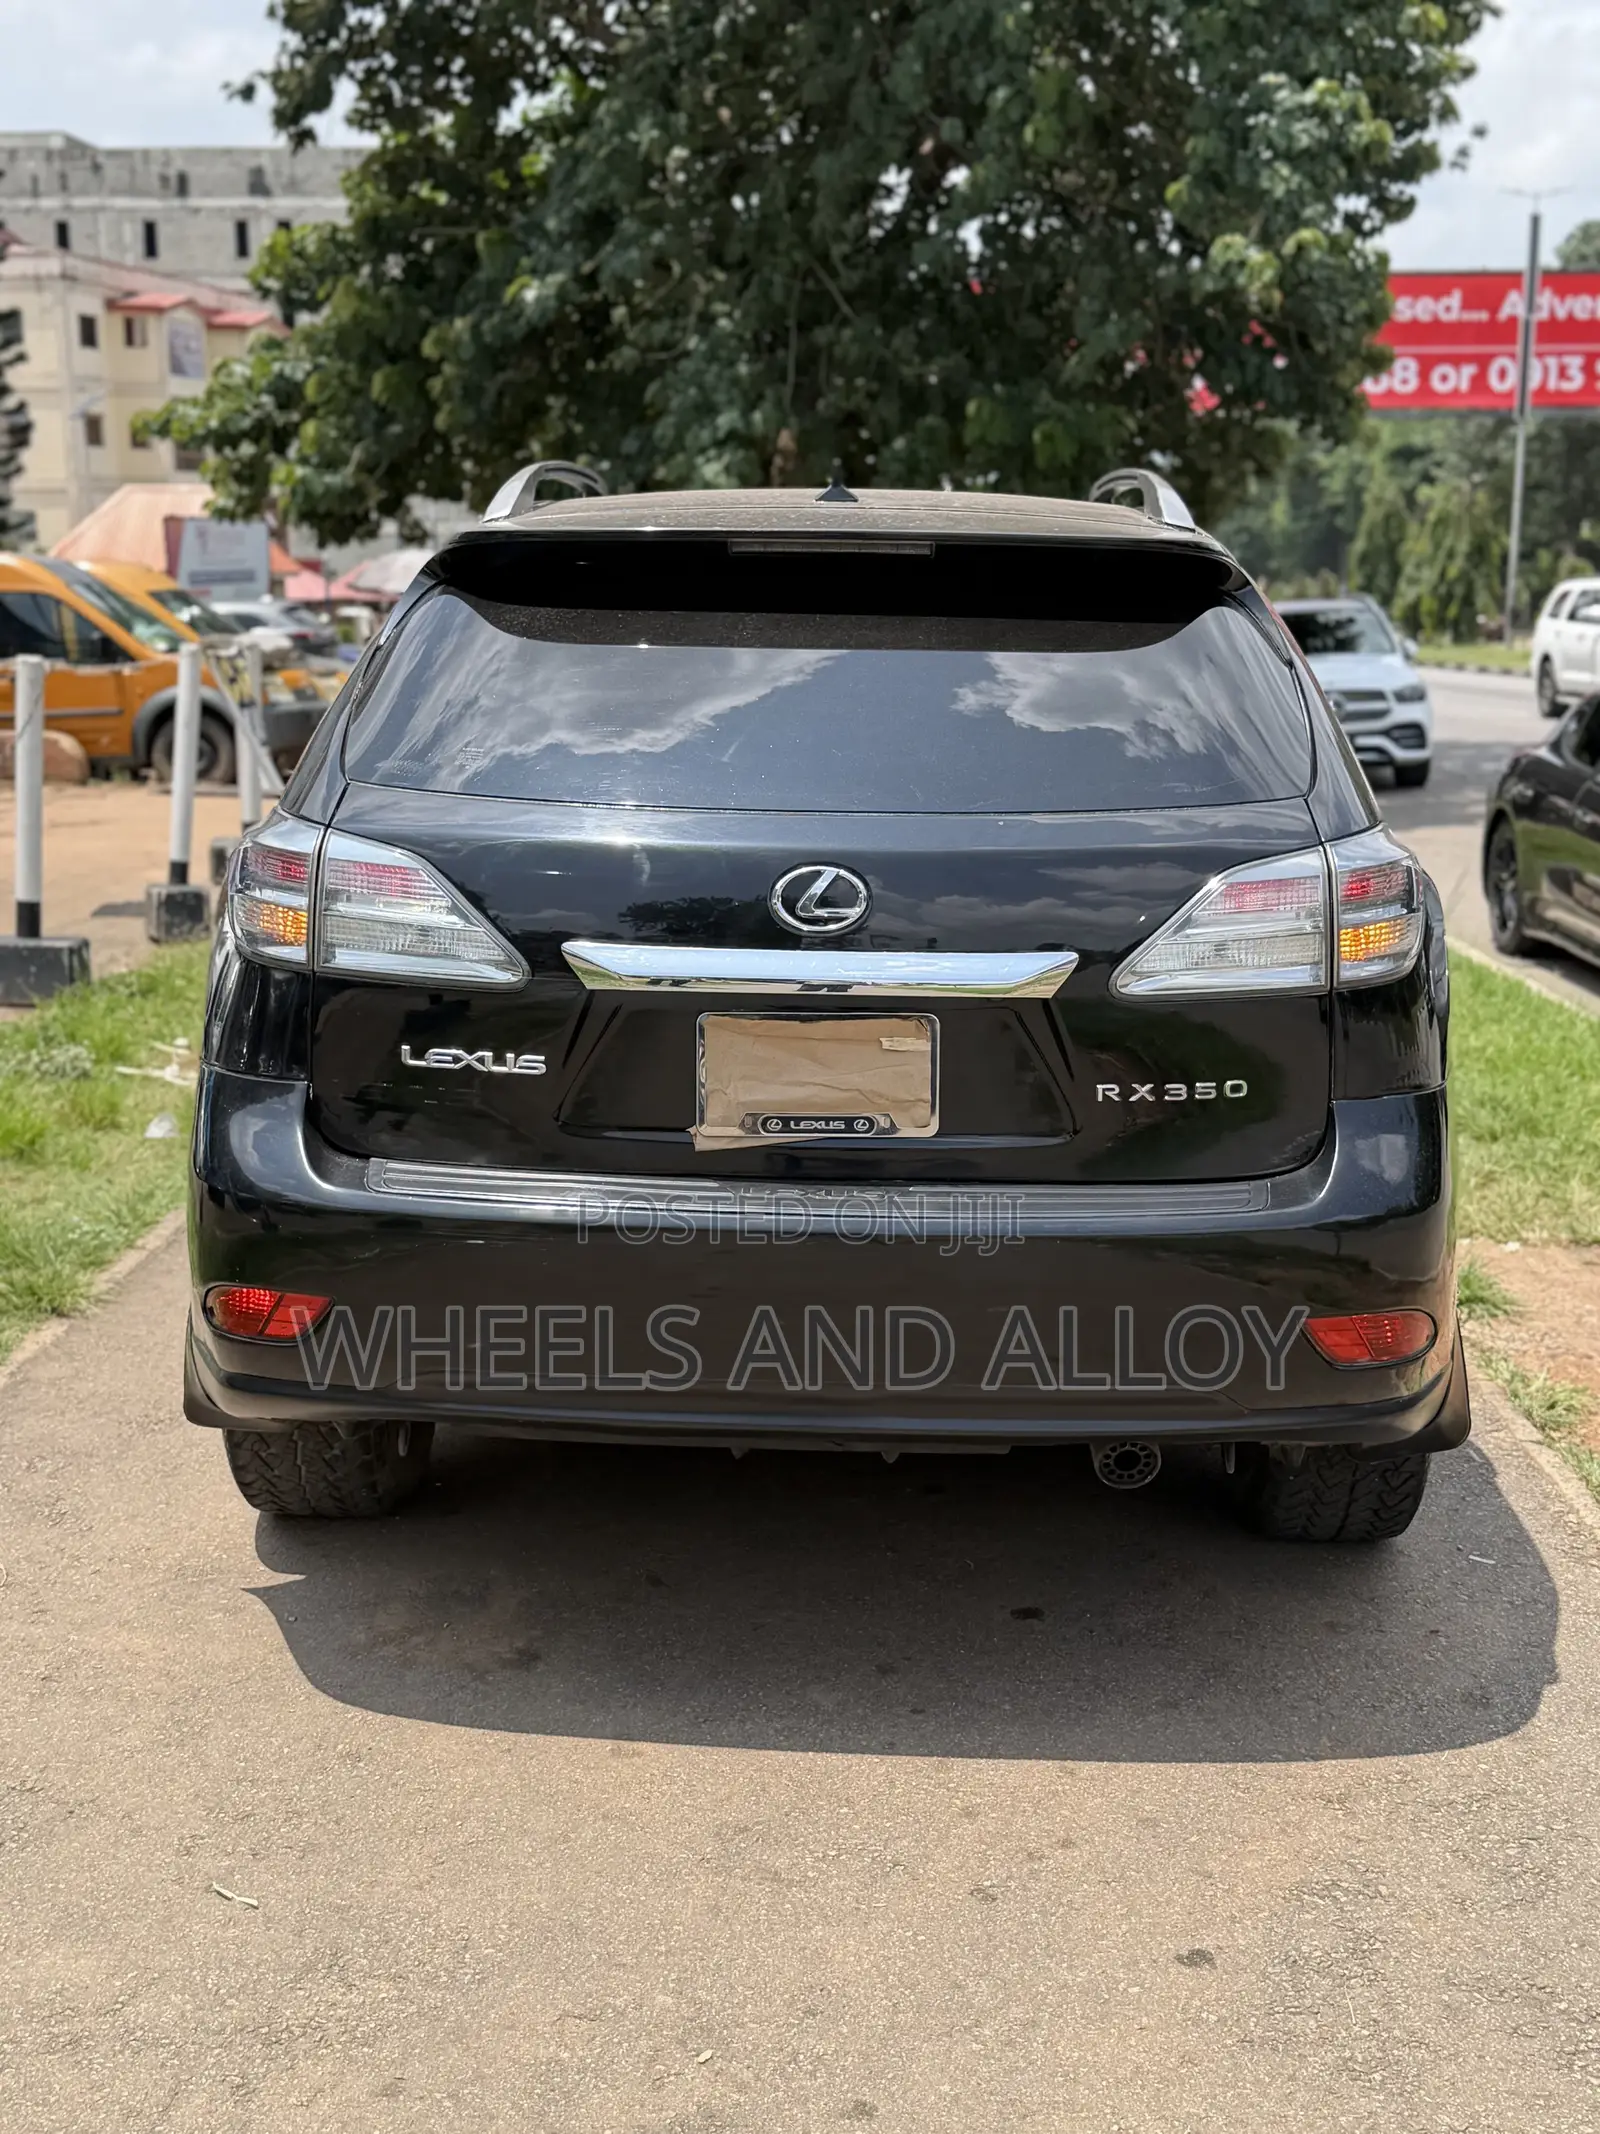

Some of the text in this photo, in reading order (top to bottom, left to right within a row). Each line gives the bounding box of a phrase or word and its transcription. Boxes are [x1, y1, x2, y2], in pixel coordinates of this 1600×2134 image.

[1429, 361, 1478, 393] or
[401, 1045, 546, 1075] LEXUS
[1096, 1080, 1248, 1101] RX350
[790, 1120, 845, 1130] LEXUS
